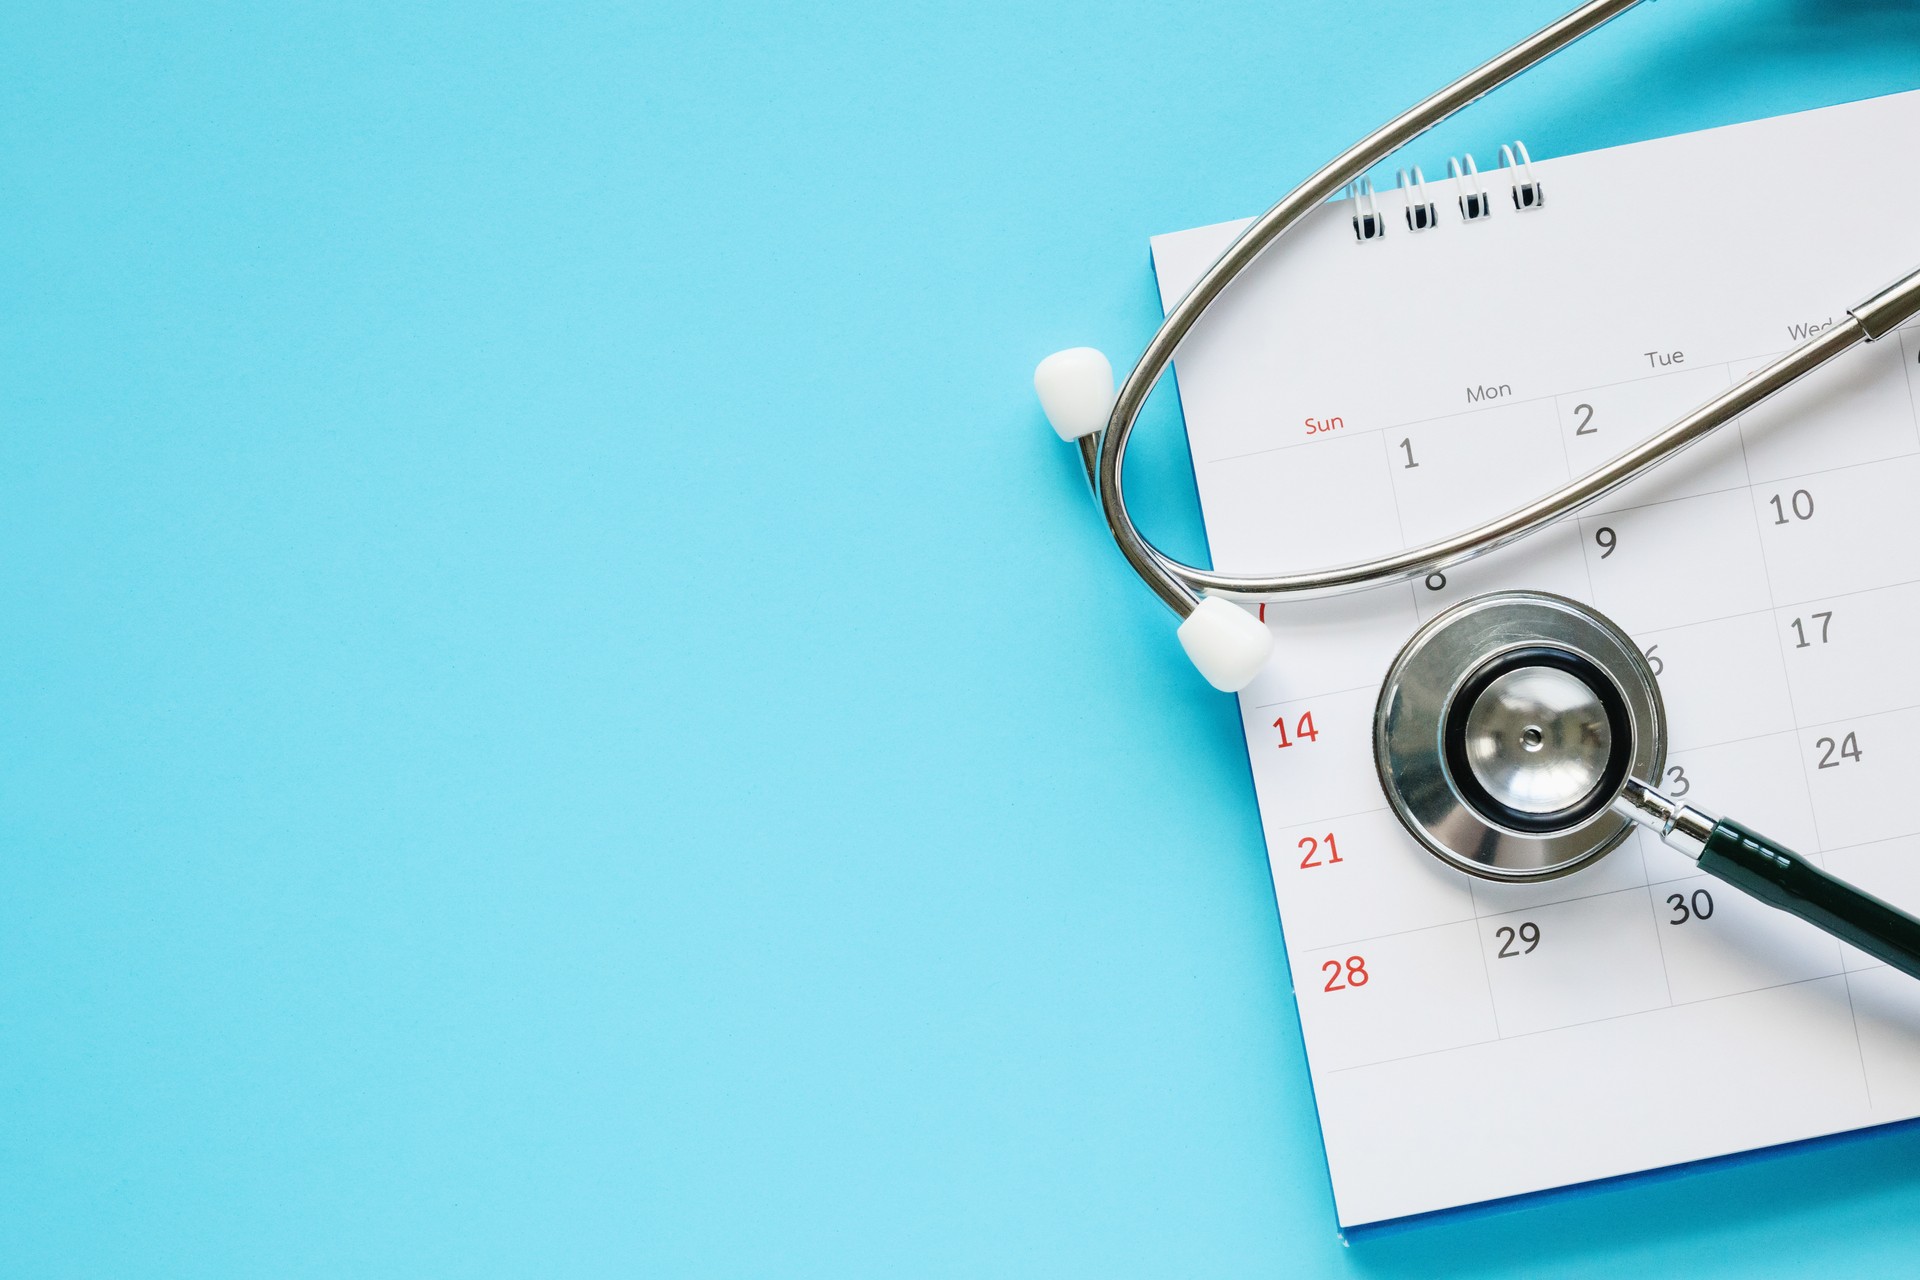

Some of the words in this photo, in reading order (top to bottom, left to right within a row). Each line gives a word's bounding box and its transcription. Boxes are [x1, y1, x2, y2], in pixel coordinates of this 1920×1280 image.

[1304, 416, 1344, 436] Sun
[1466, 384, 1512, 404] Mon
[1643, 351, 1685, 368] Tue
[1399, 437, 1420, 469] 1
[1573, 403, 1598, 436] 2
[1594, 527, 1617, 559] 9
[1769, 489, 1815, 525] 10
[1645, 644, 1664, 676] 6
[1790, 610, 1833, 649] 17
[1272, 710, 1320, 749] 14
[1666, 765, 1690, 797] 3
[1815, 731, 1863, 770] 24
[1297, 832, 1344, 870] 21
[1321, 955, 1370, 993] 28
[1495, 921, 1541, 959] 29
[1666, 888, 1714, 926] 30
